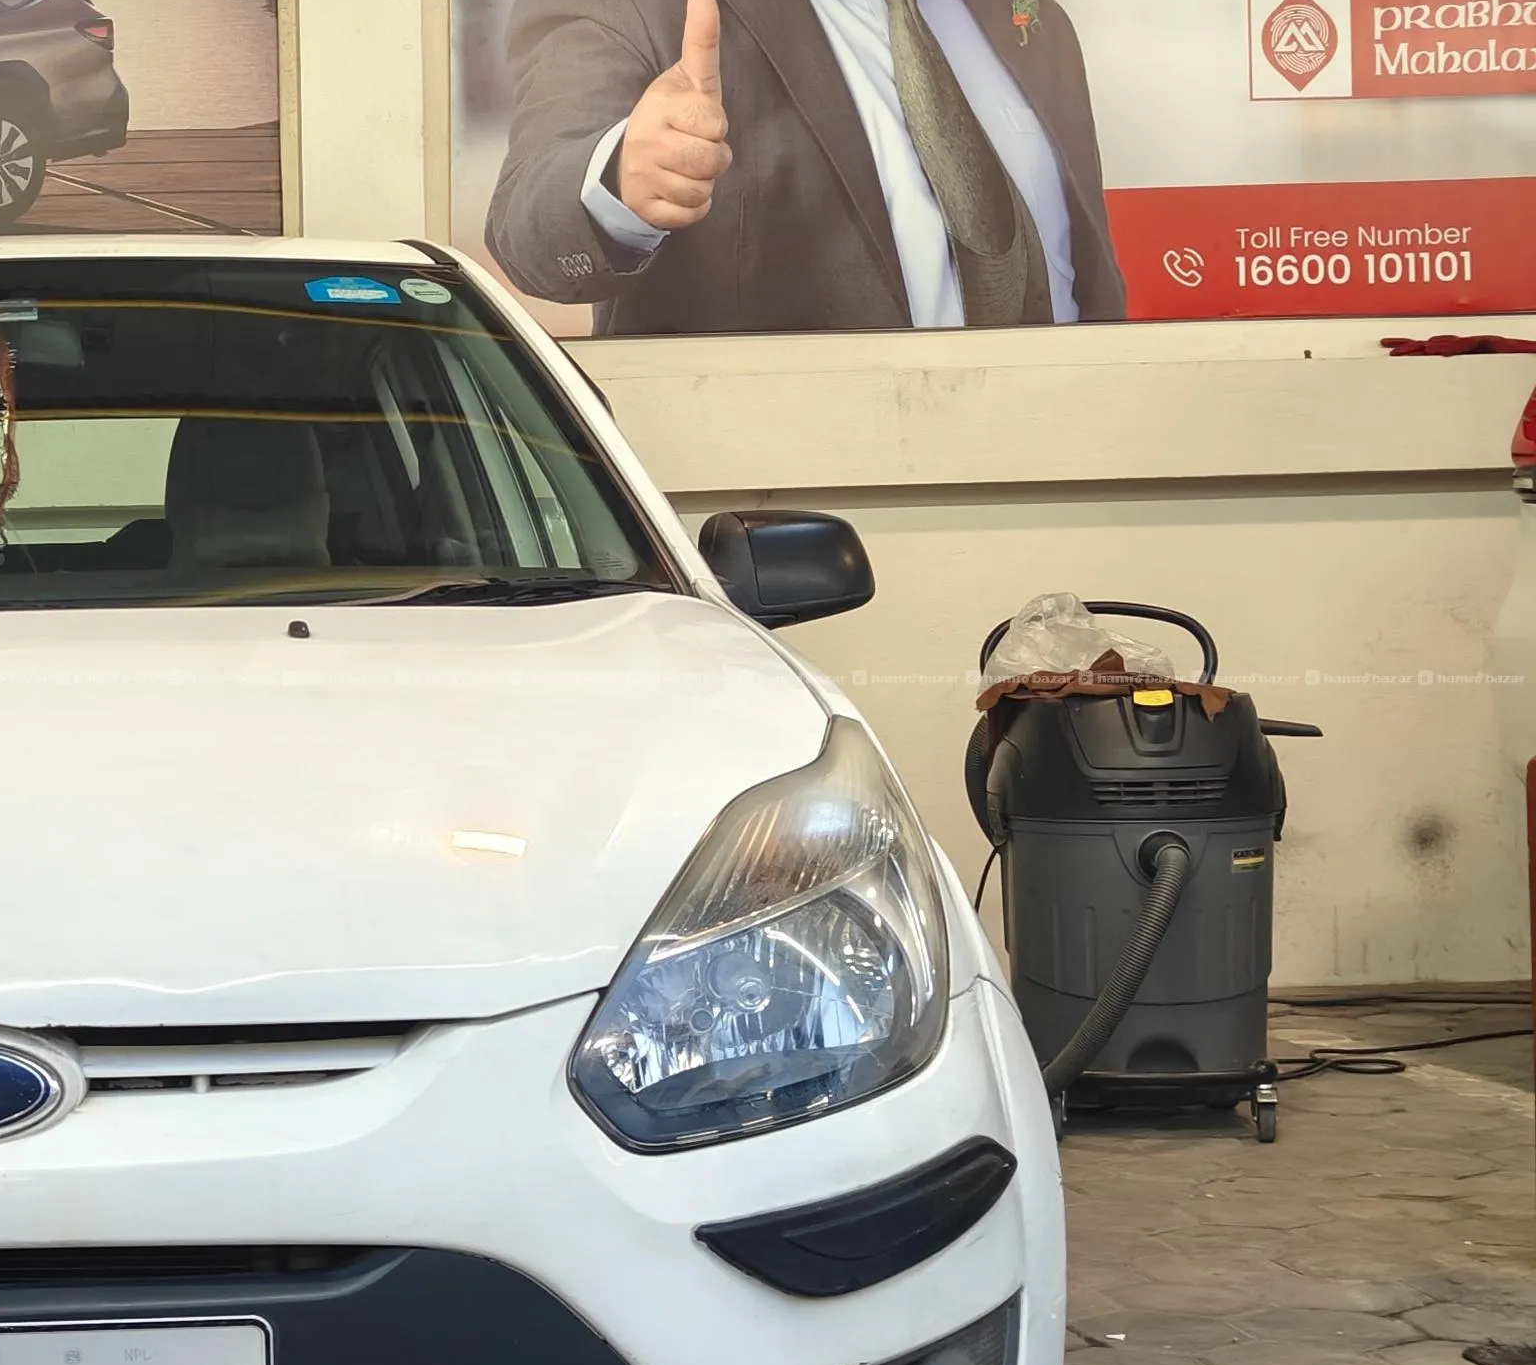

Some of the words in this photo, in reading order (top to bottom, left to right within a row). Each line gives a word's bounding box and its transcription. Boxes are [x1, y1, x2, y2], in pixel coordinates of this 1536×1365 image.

[1235, 227, 1281, 249] Toll
[1290, 226, 1349, 248] Free
[1357, 223, 1472, 248] Number
[1234, 253, 1351, 287] 16600
[1363, 250, 1472, 284] 101101
[123, 1348, 152, 1363] NPL
